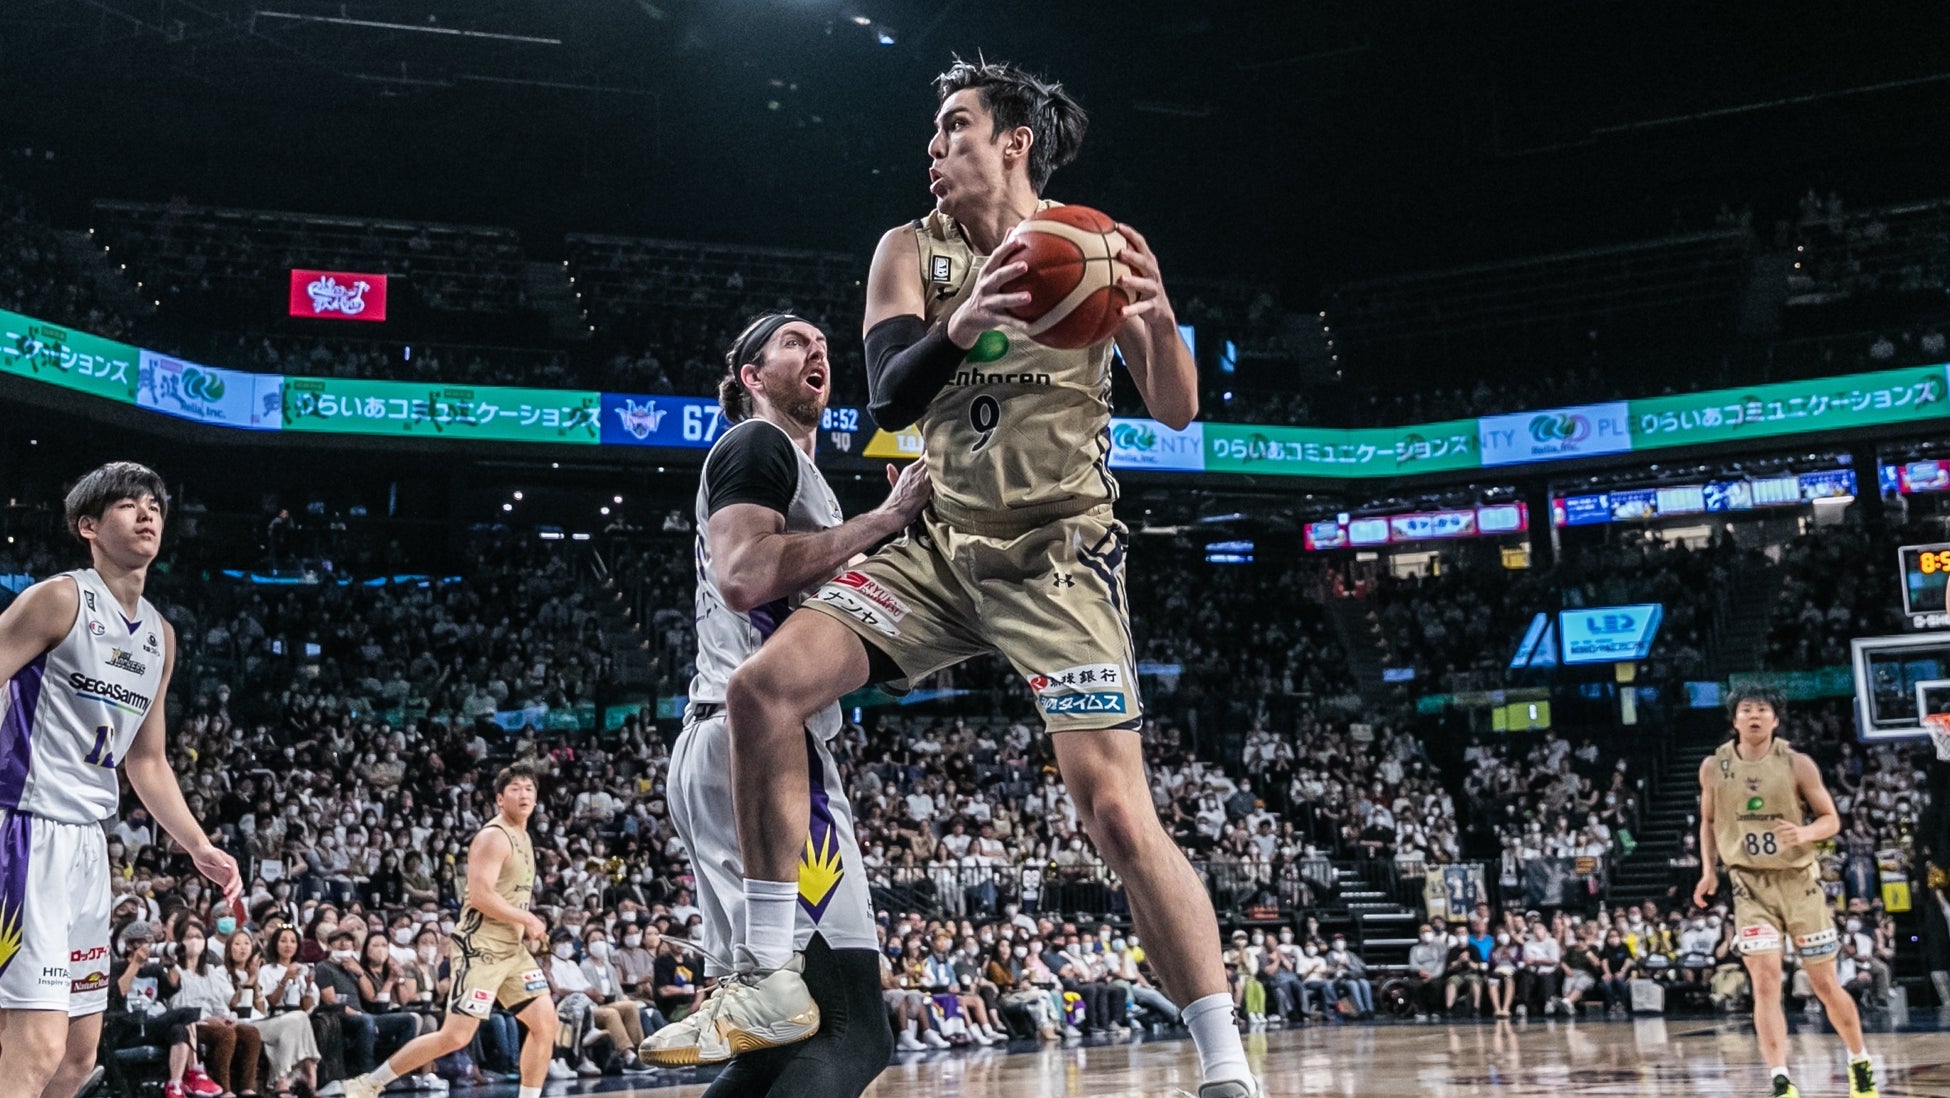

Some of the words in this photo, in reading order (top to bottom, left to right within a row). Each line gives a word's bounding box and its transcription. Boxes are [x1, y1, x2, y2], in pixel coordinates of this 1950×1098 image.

[822, 407, 859, 432] 8:52
[969, 394, 1000, 452] 9
[1744, 831, 1778, 856] 88
[42, 966, 71, 979] HITA
